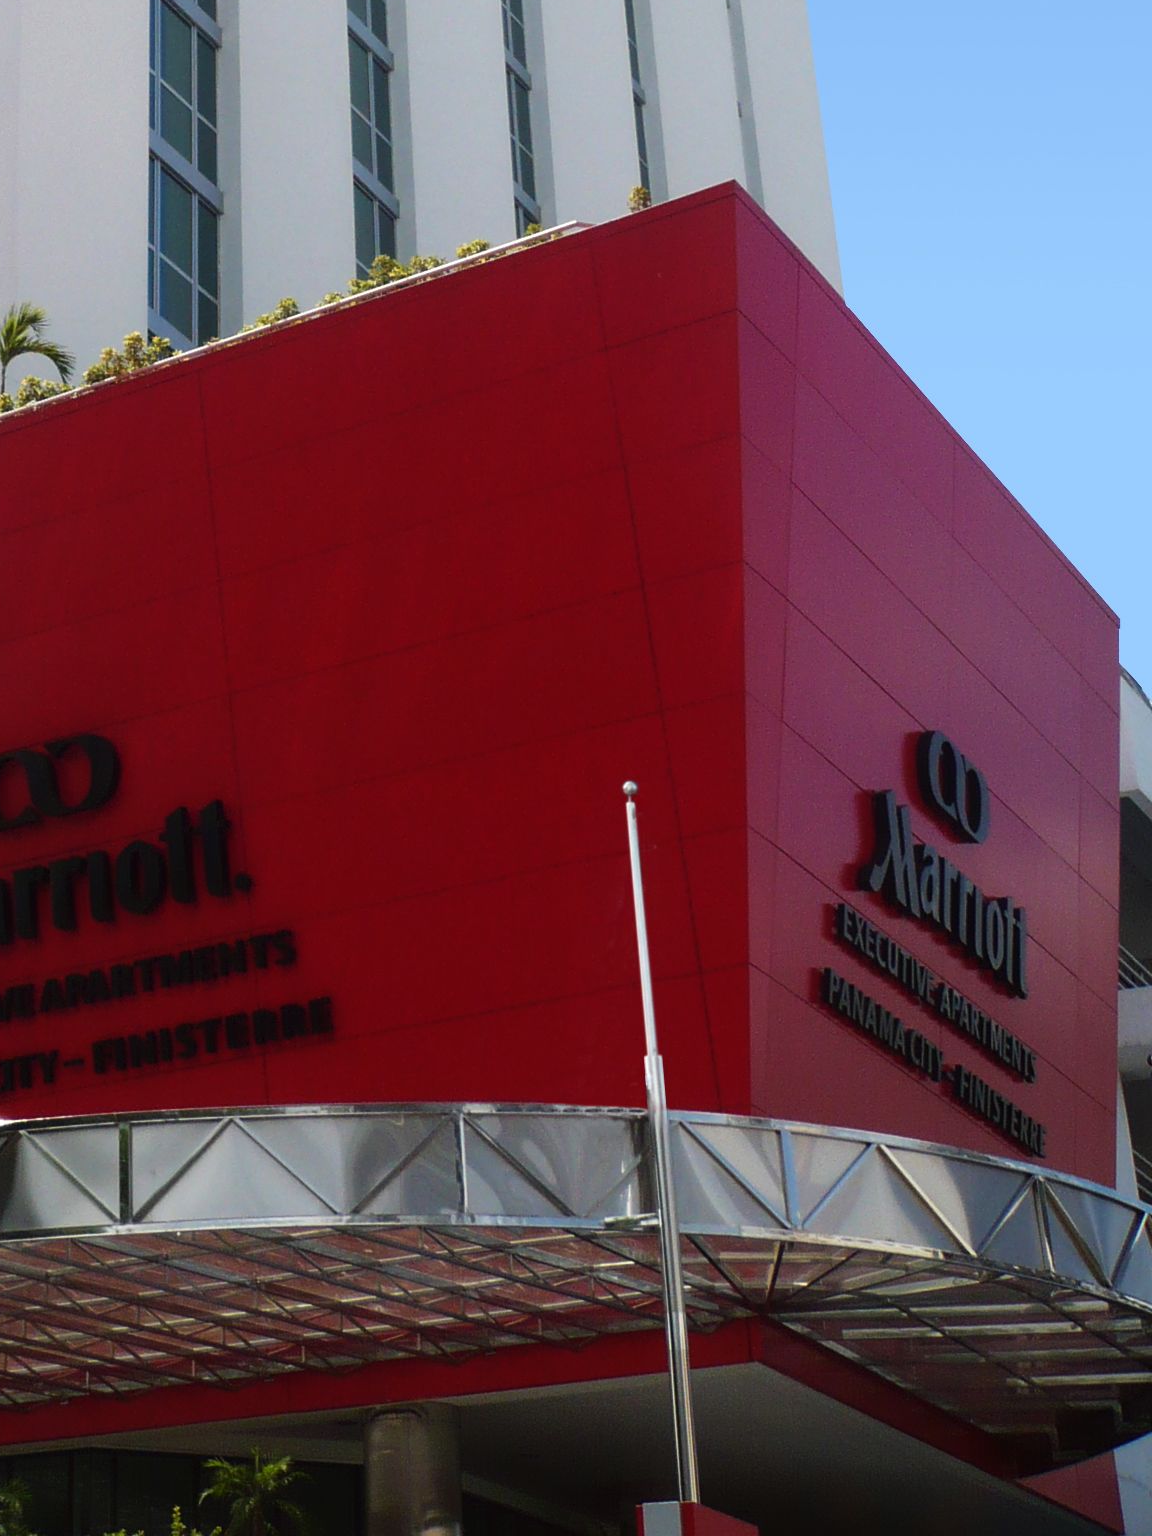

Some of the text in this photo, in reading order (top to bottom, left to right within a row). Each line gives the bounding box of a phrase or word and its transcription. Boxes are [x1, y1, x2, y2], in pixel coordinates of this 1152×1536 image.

[40, 929, 297, 1013] APARTMENTS
[92, 996, 335, 1075] FINISTERRE
[837, 903, 1038, 1084] EXECUTIVE APARTMENTS
[824, 968, 907, 1057] PANAMA
[908, 1029, 944, 1083] CITY
[955, 1065, 1047, 1158] FINISTERRE
